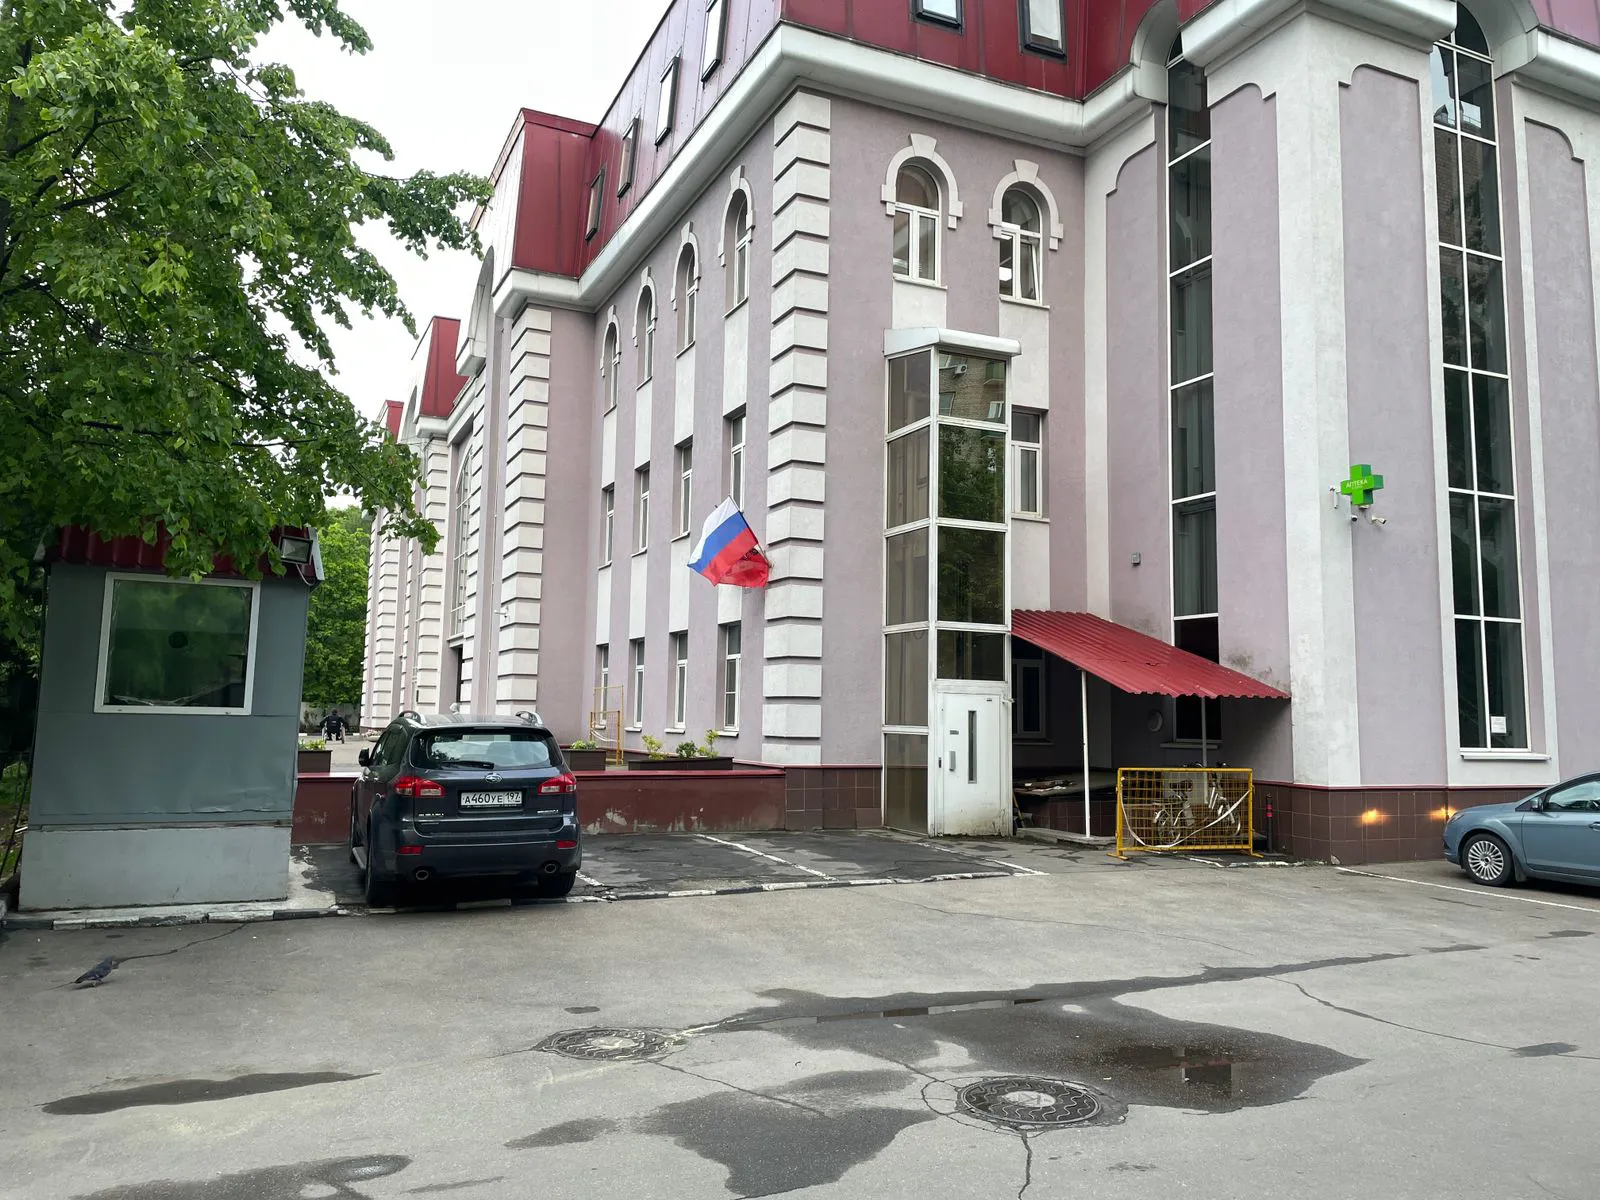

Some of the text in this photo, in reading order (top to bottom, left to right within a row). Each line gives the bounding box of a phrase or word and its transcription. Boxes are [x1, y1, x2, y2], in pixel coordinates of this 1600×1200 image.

[1346, 479, 1368, 488] АПТЕКА
[465, 792, 519, 804] А460УЕ 197
